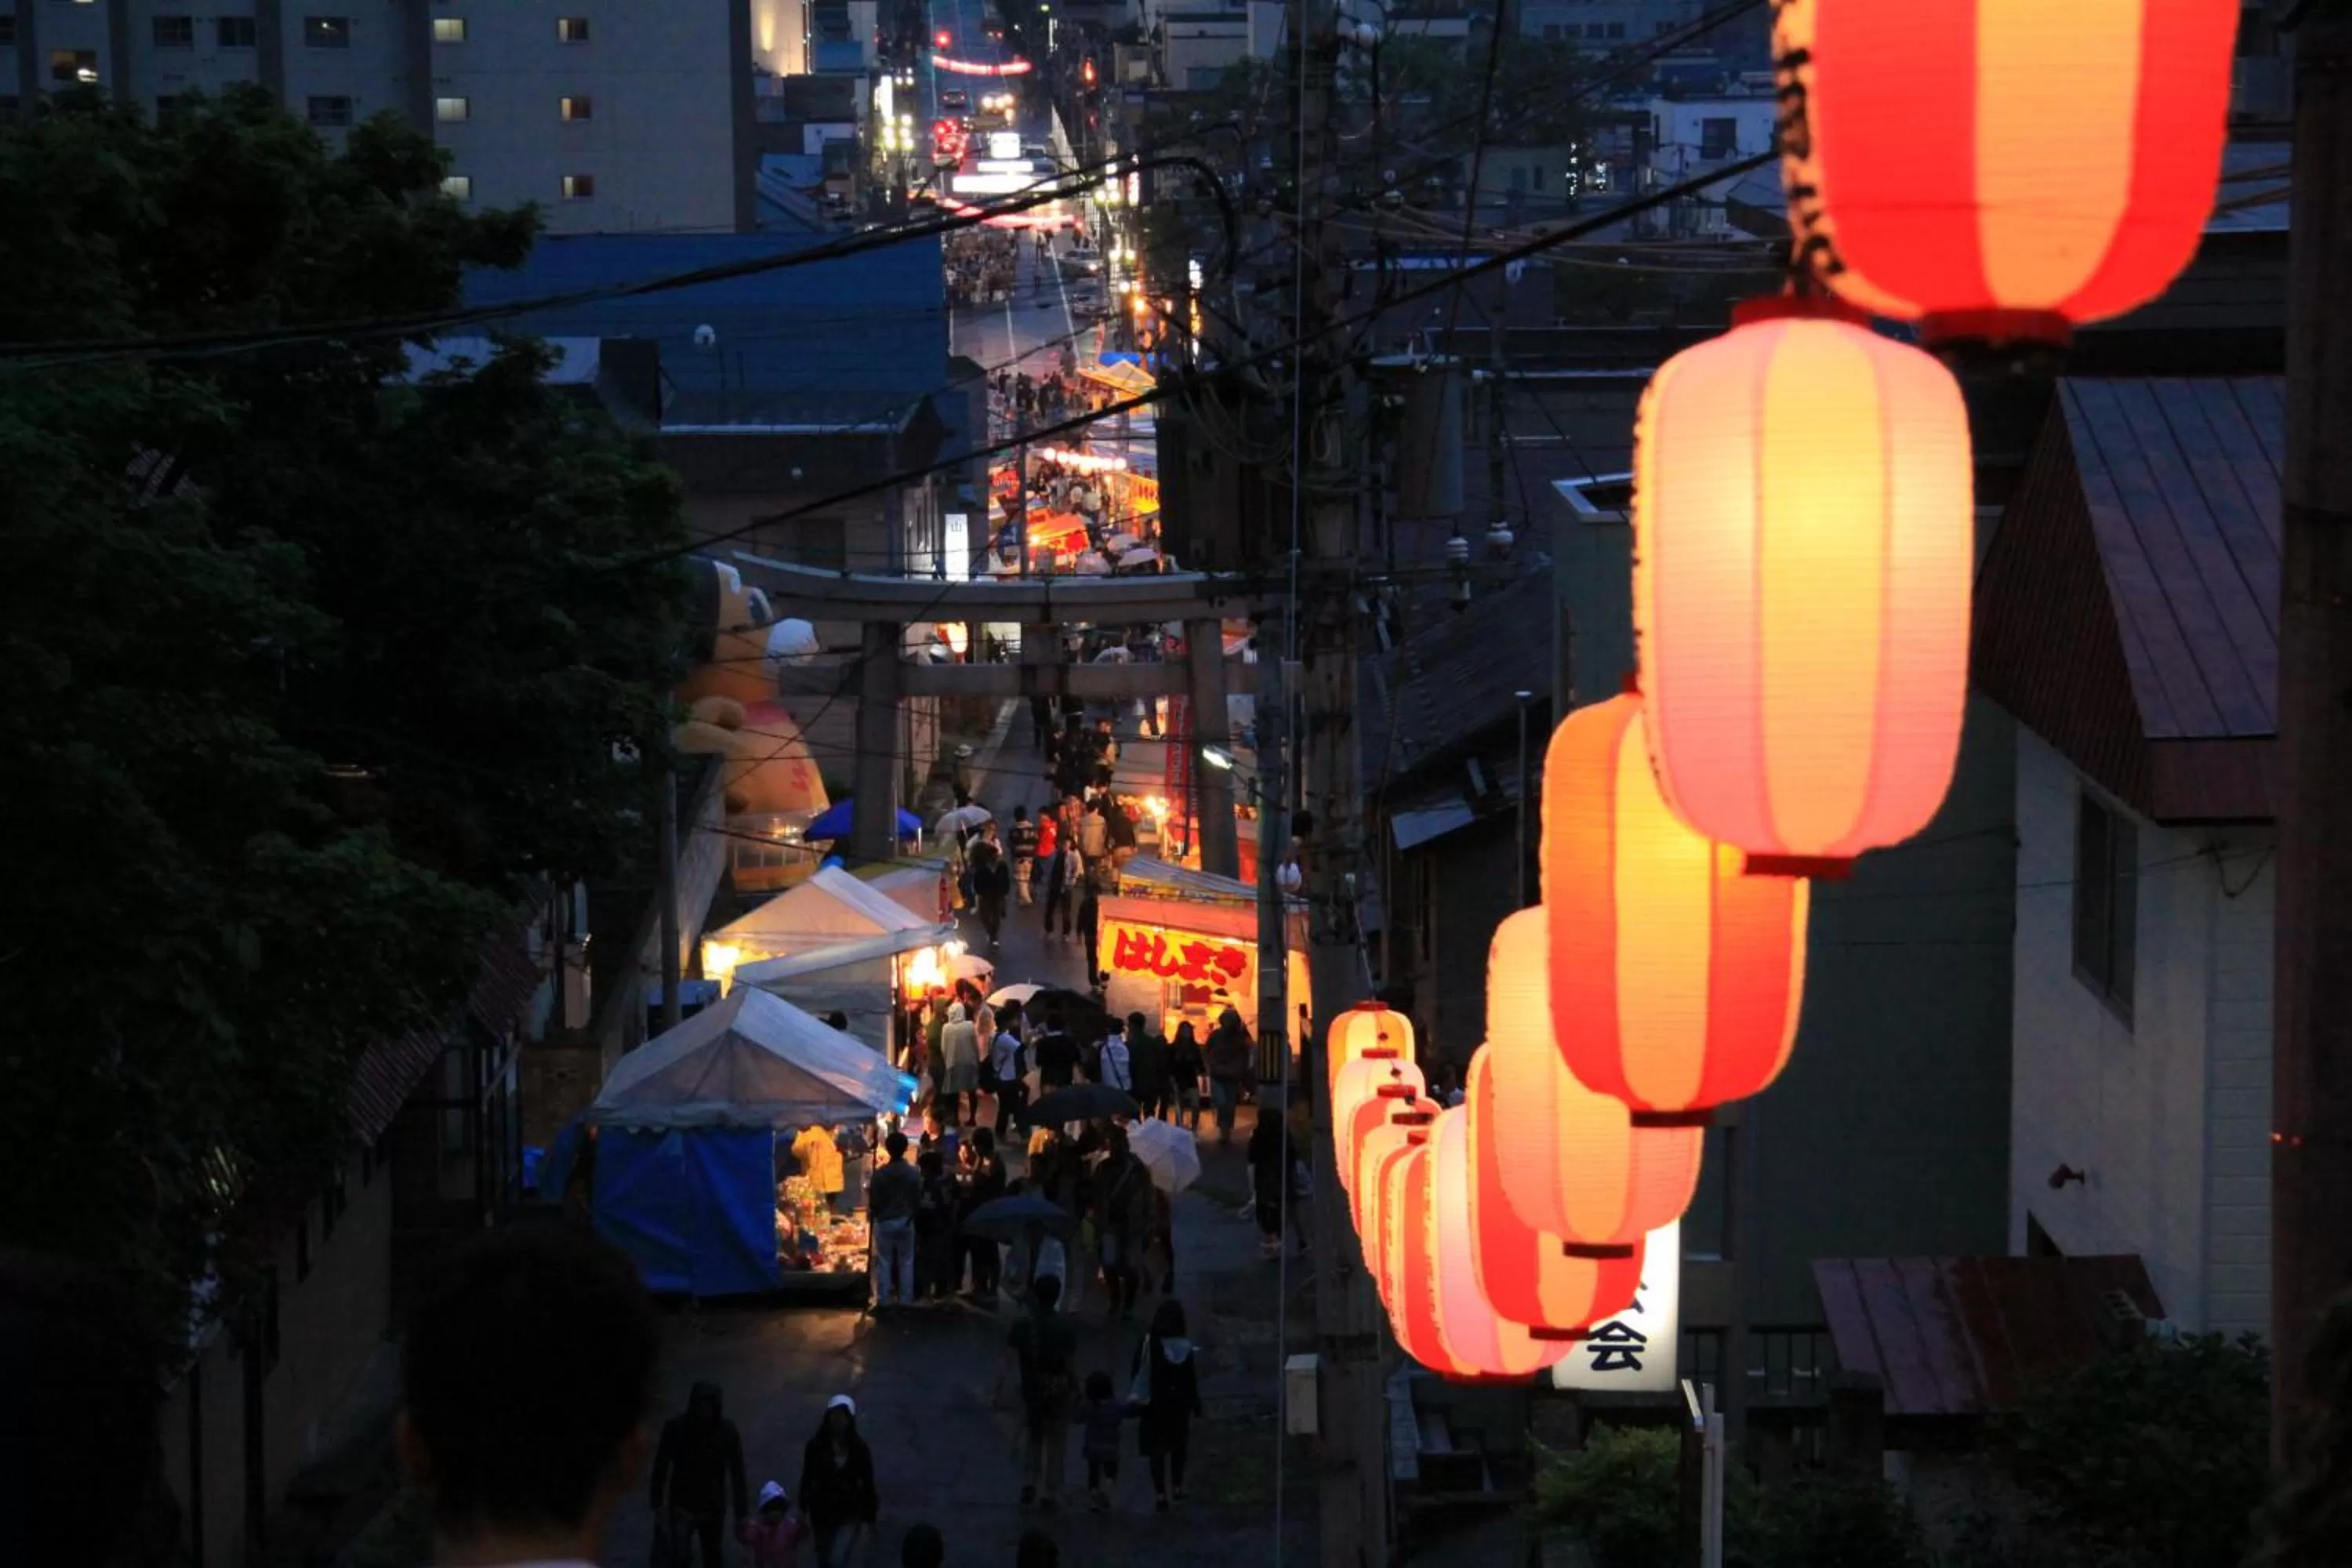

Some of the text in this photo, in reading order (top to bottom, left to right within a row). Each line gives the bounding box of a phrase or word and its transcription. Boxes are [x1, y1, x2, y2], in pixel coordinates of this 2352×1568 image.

[1113, 928, 1247, 985] はしまき
[1586, 1280, 1647, 1371] 会
